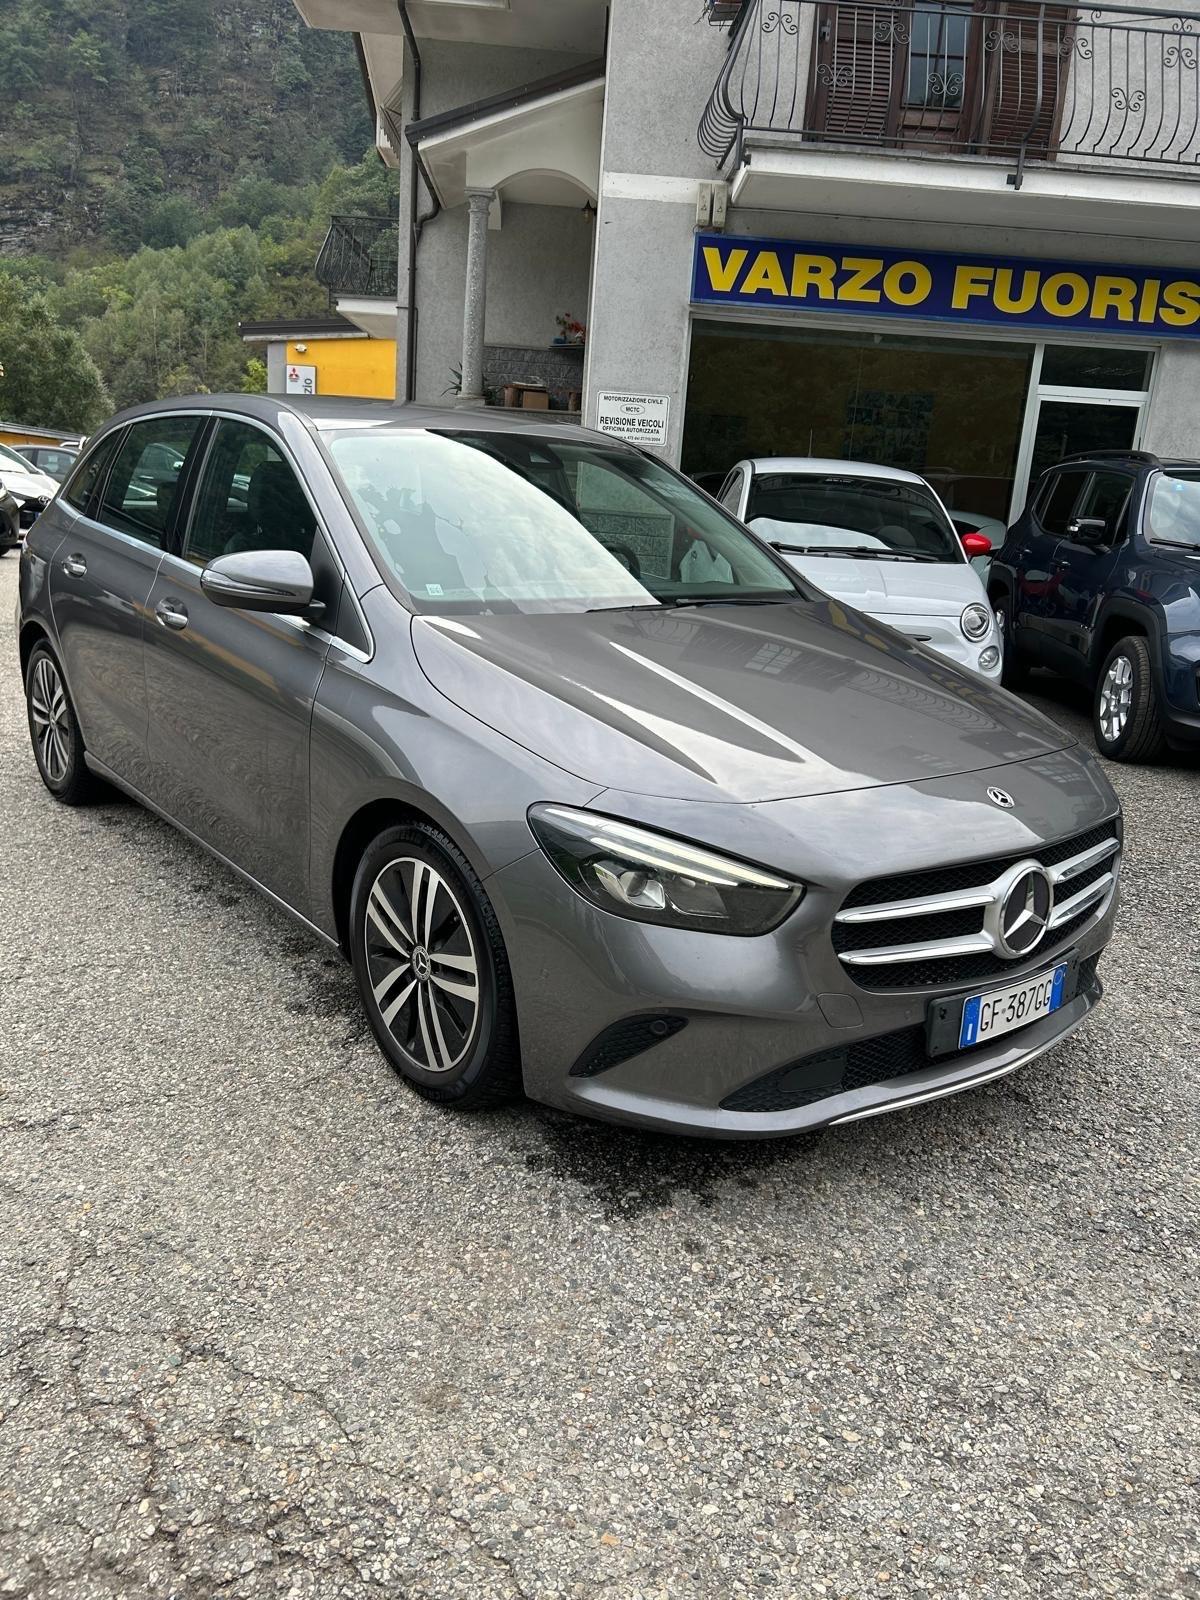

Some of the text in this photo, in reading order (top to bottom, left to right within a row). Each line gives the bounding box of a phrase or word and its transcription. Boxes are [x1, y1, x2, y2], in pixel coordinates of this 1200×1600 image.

[702, 247, 1200, 326] VARZO FUORIS
[603, 395, 646, 404] MOTORIZZAZIONE
[600, 416, 664, 429] REVISIONE VEICOLI
[602, 425, 660, 434] OFFICINA AUTORIZZATA
